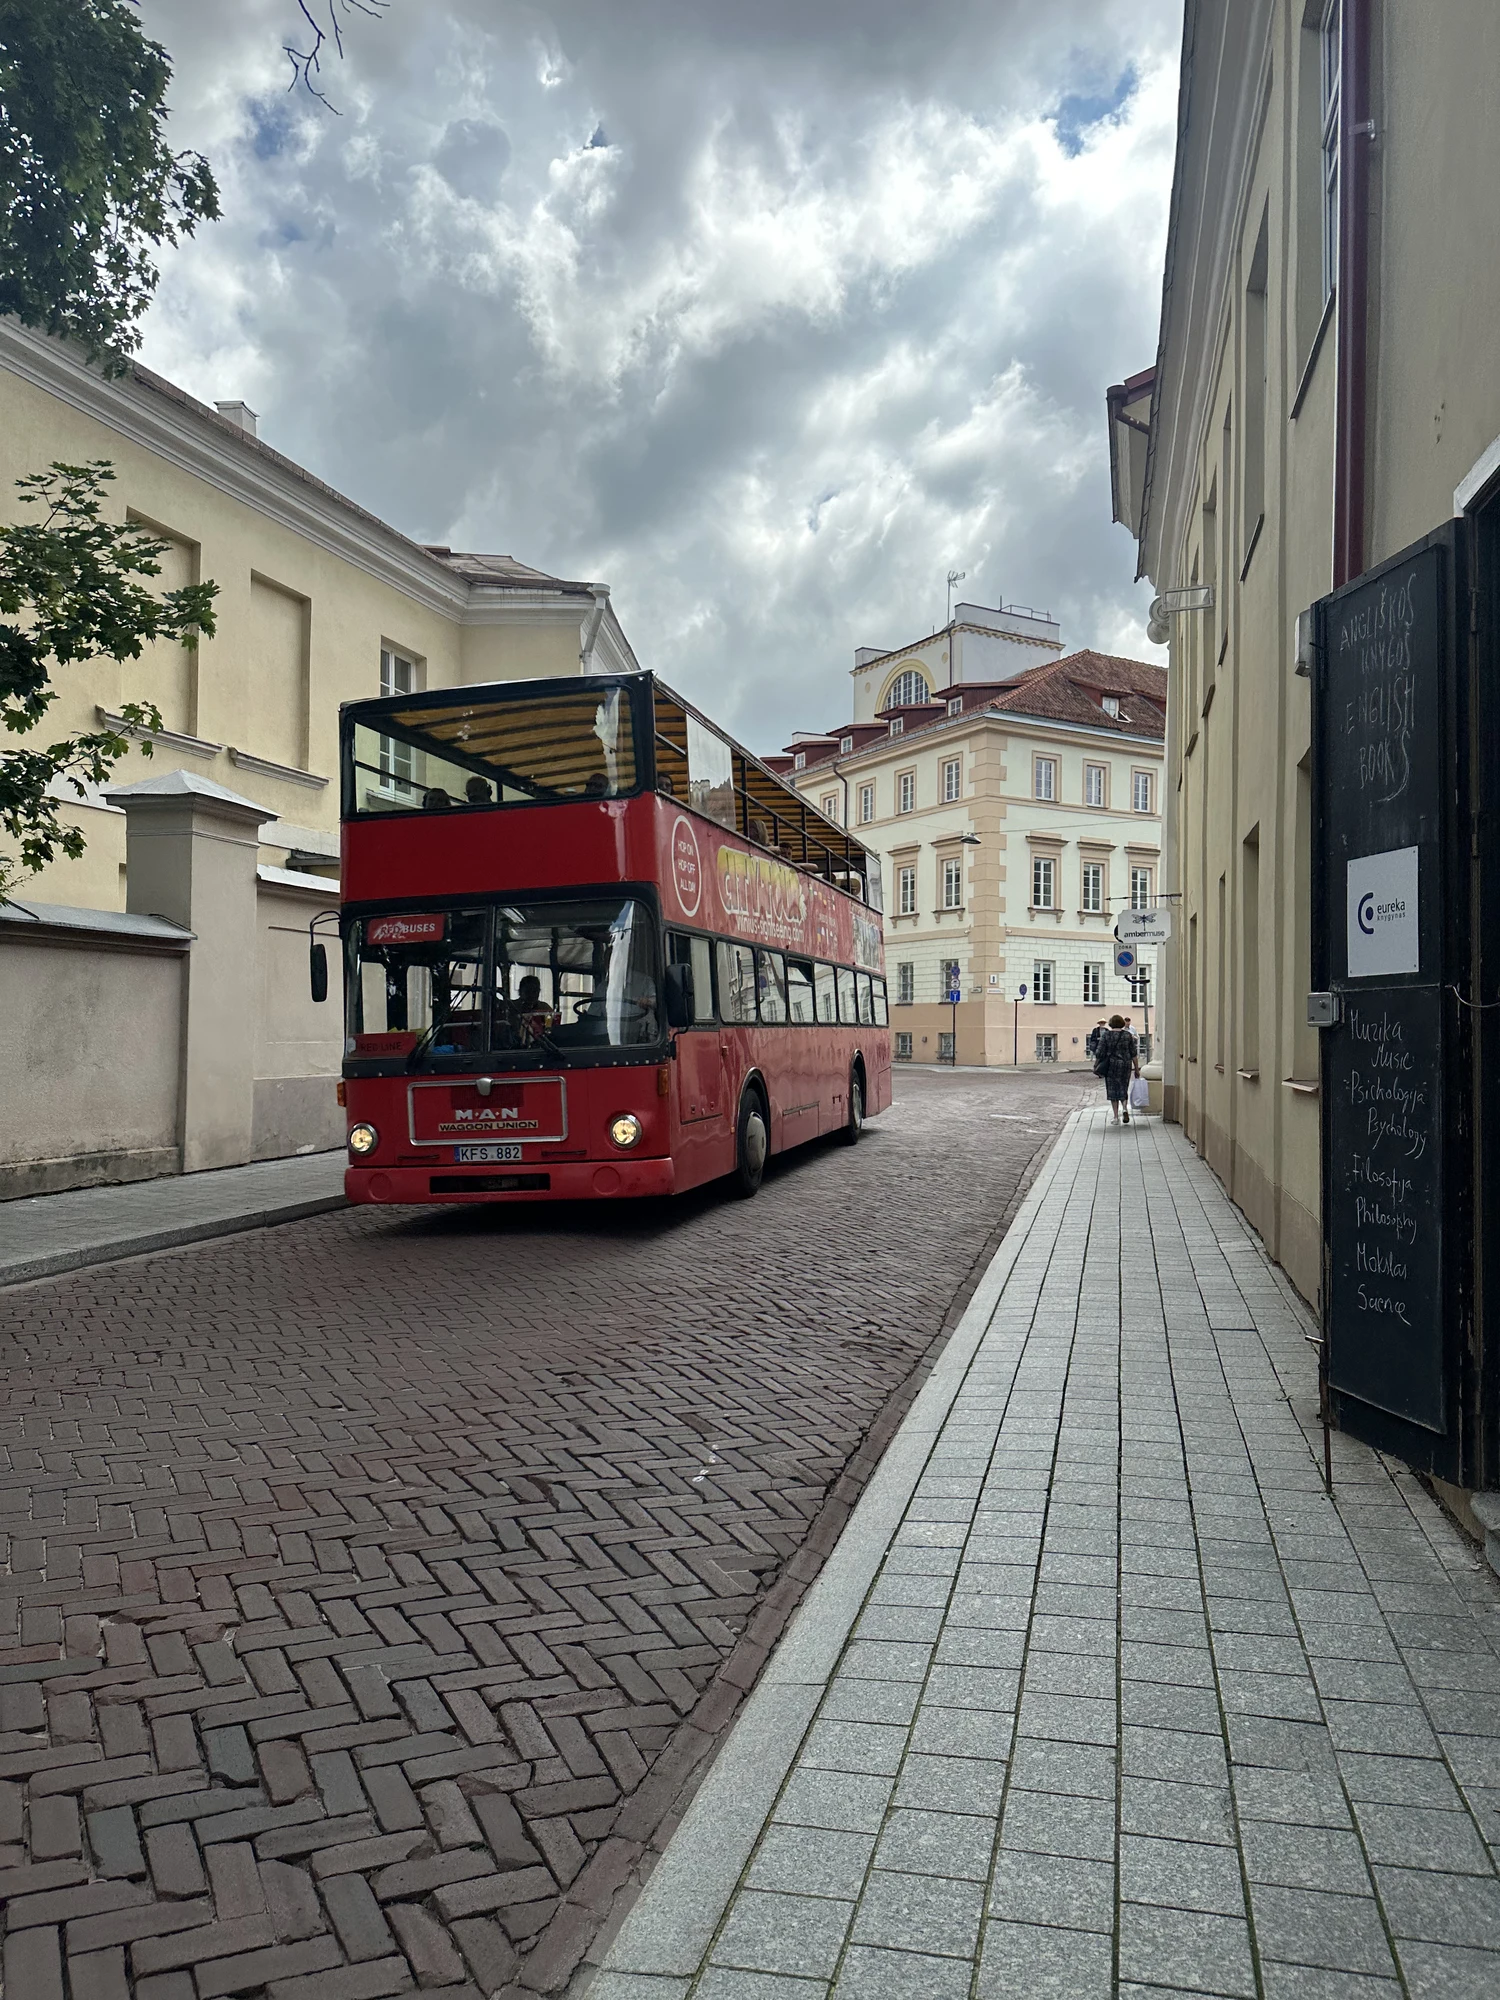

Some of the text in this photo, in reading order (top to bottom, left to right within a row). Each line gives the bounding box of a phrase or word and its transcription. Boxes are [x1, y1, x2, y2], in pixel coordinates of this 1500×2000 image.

[1361, 632, 1410, 674] KNYGOS
[1346, 674, 1415, 735] ENGLISH
[1360, 729, 1410, 802] BOOKS
[678, 840, 694, 856] HOP ON
[678, 859, 695, 875] HOP OFF
[680, 878, 696, 893] ALL DAY
[1377, 898, 1406, 914] eureka
[1377, 912, 1406, 922] knygynas
[402, 923, 435, 933] BUSES
[1124, 930, 1164, 938] ambermuse
[1350, 1009, 1402, 1042] Muzika
[360, 1042, 402, 1052] RED LINE
[1371, 1043, 1413, 1070] Music
[1351, 1069, 1425, 1114] Psichologija
[439, 1121, 537, 1132] WAGGON UNION
[1367, 1106, 1426, 1160] Psychology
[461, 1147, 488, 1160] KFS
[496, 1147, 520, 1160] 882
[1355, 1196, 1416, 1245] Philosophy
